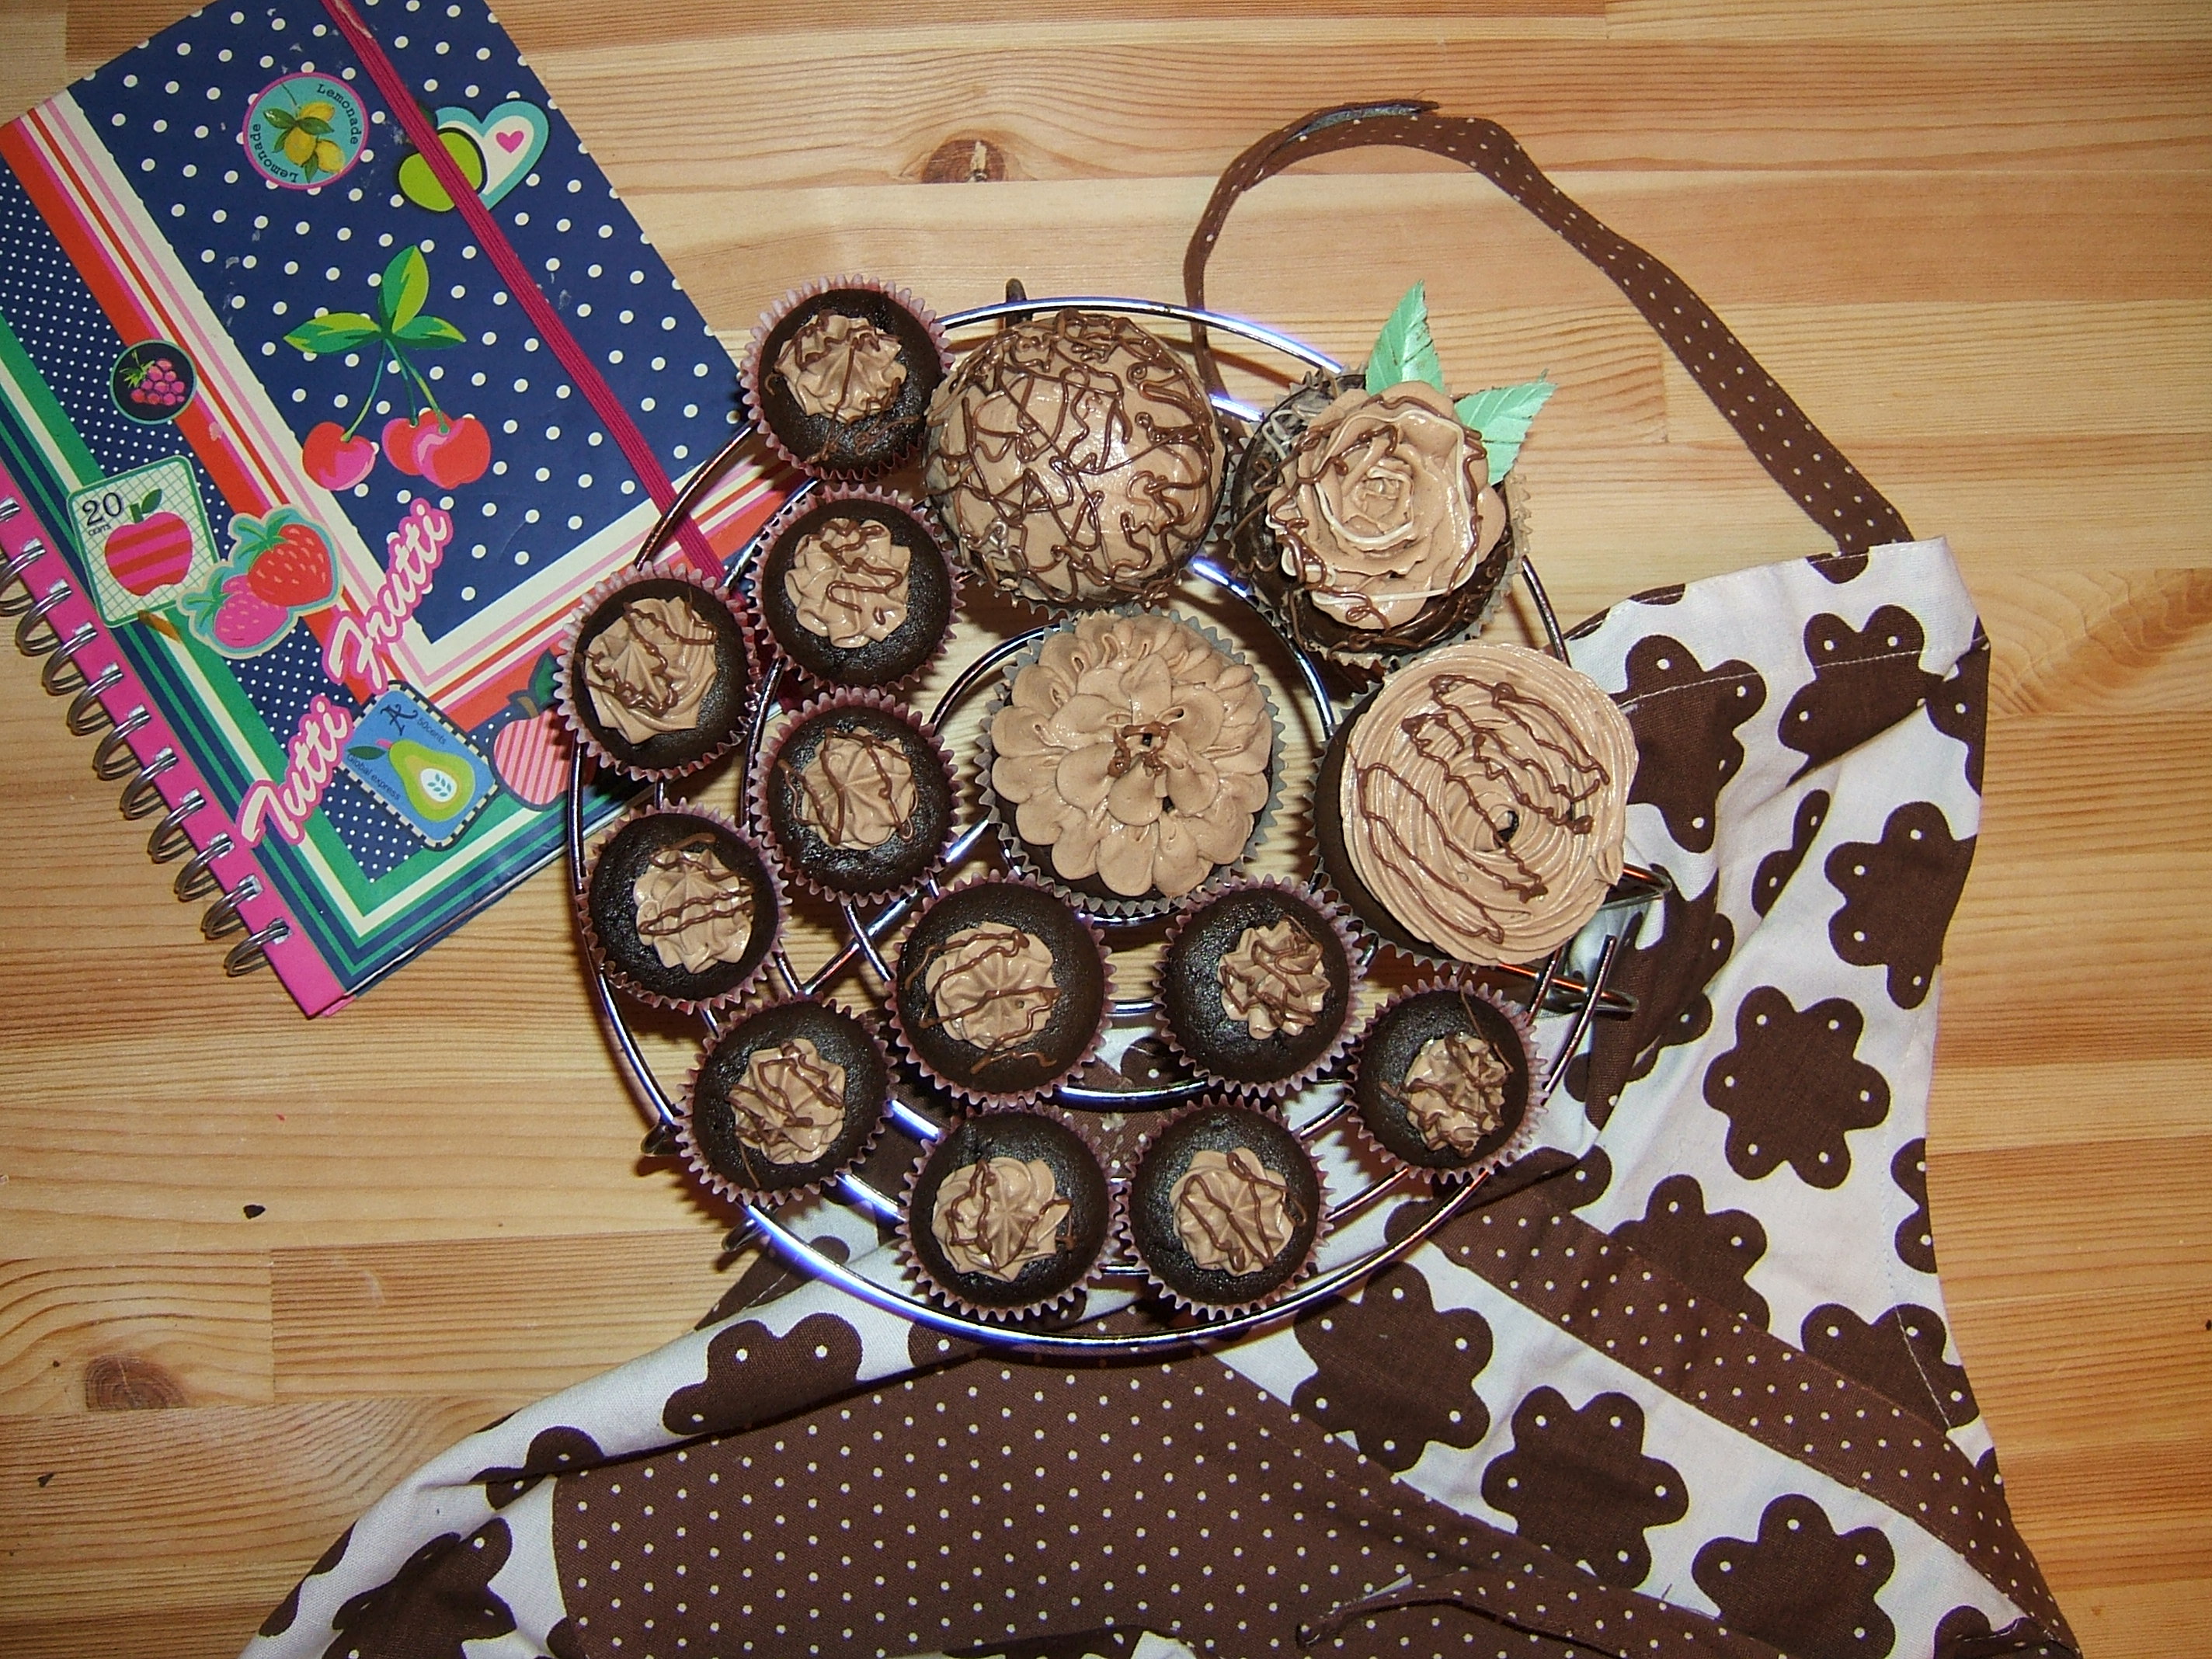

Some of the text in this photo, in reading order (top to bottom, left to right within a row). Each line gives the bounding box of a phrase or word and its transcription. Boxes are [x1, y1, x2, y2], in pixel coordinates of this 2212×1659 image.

[316, 83, 362, 145] Lemonade
[250, 123, 299, 183] Lemonade
[82, 492, 123, 527] 20
[238, 501, 450, 844] Tutti Frutti
[417, 717, 447, 746] 50cents
[347, 754, 402, 802] Global express
